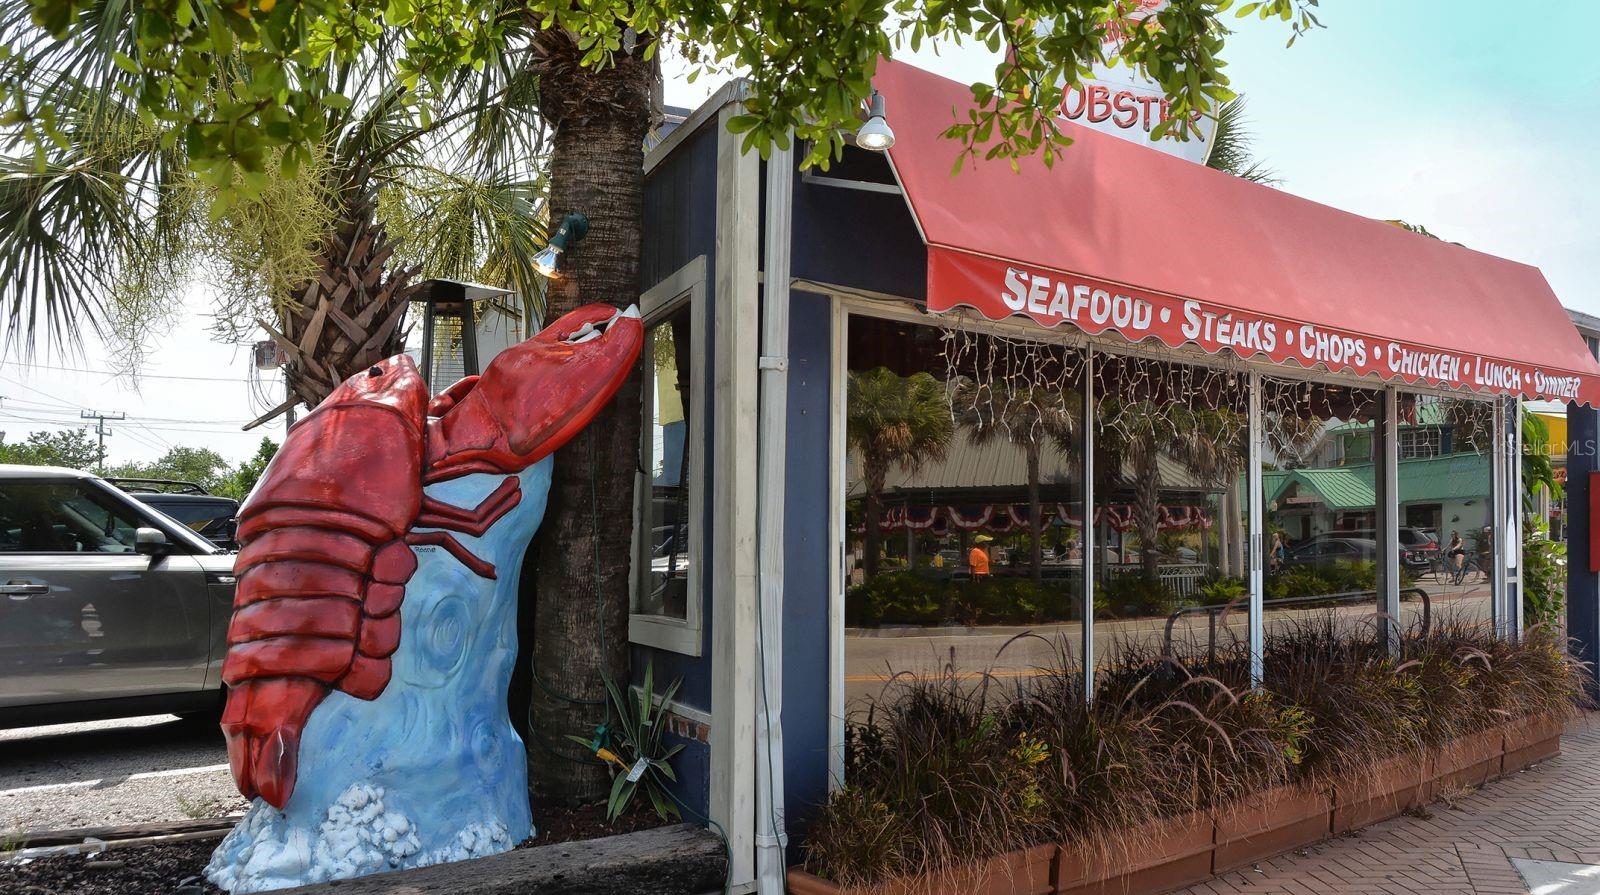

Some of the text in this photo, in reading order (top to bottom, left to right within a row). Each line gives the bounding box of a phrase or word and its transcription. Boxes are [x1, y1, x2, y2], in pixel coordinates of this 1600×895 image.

[1001, 266, 1581, 398] SEAFOOD STEAKS CHOPS CHICKEN LUNCH DINNER
